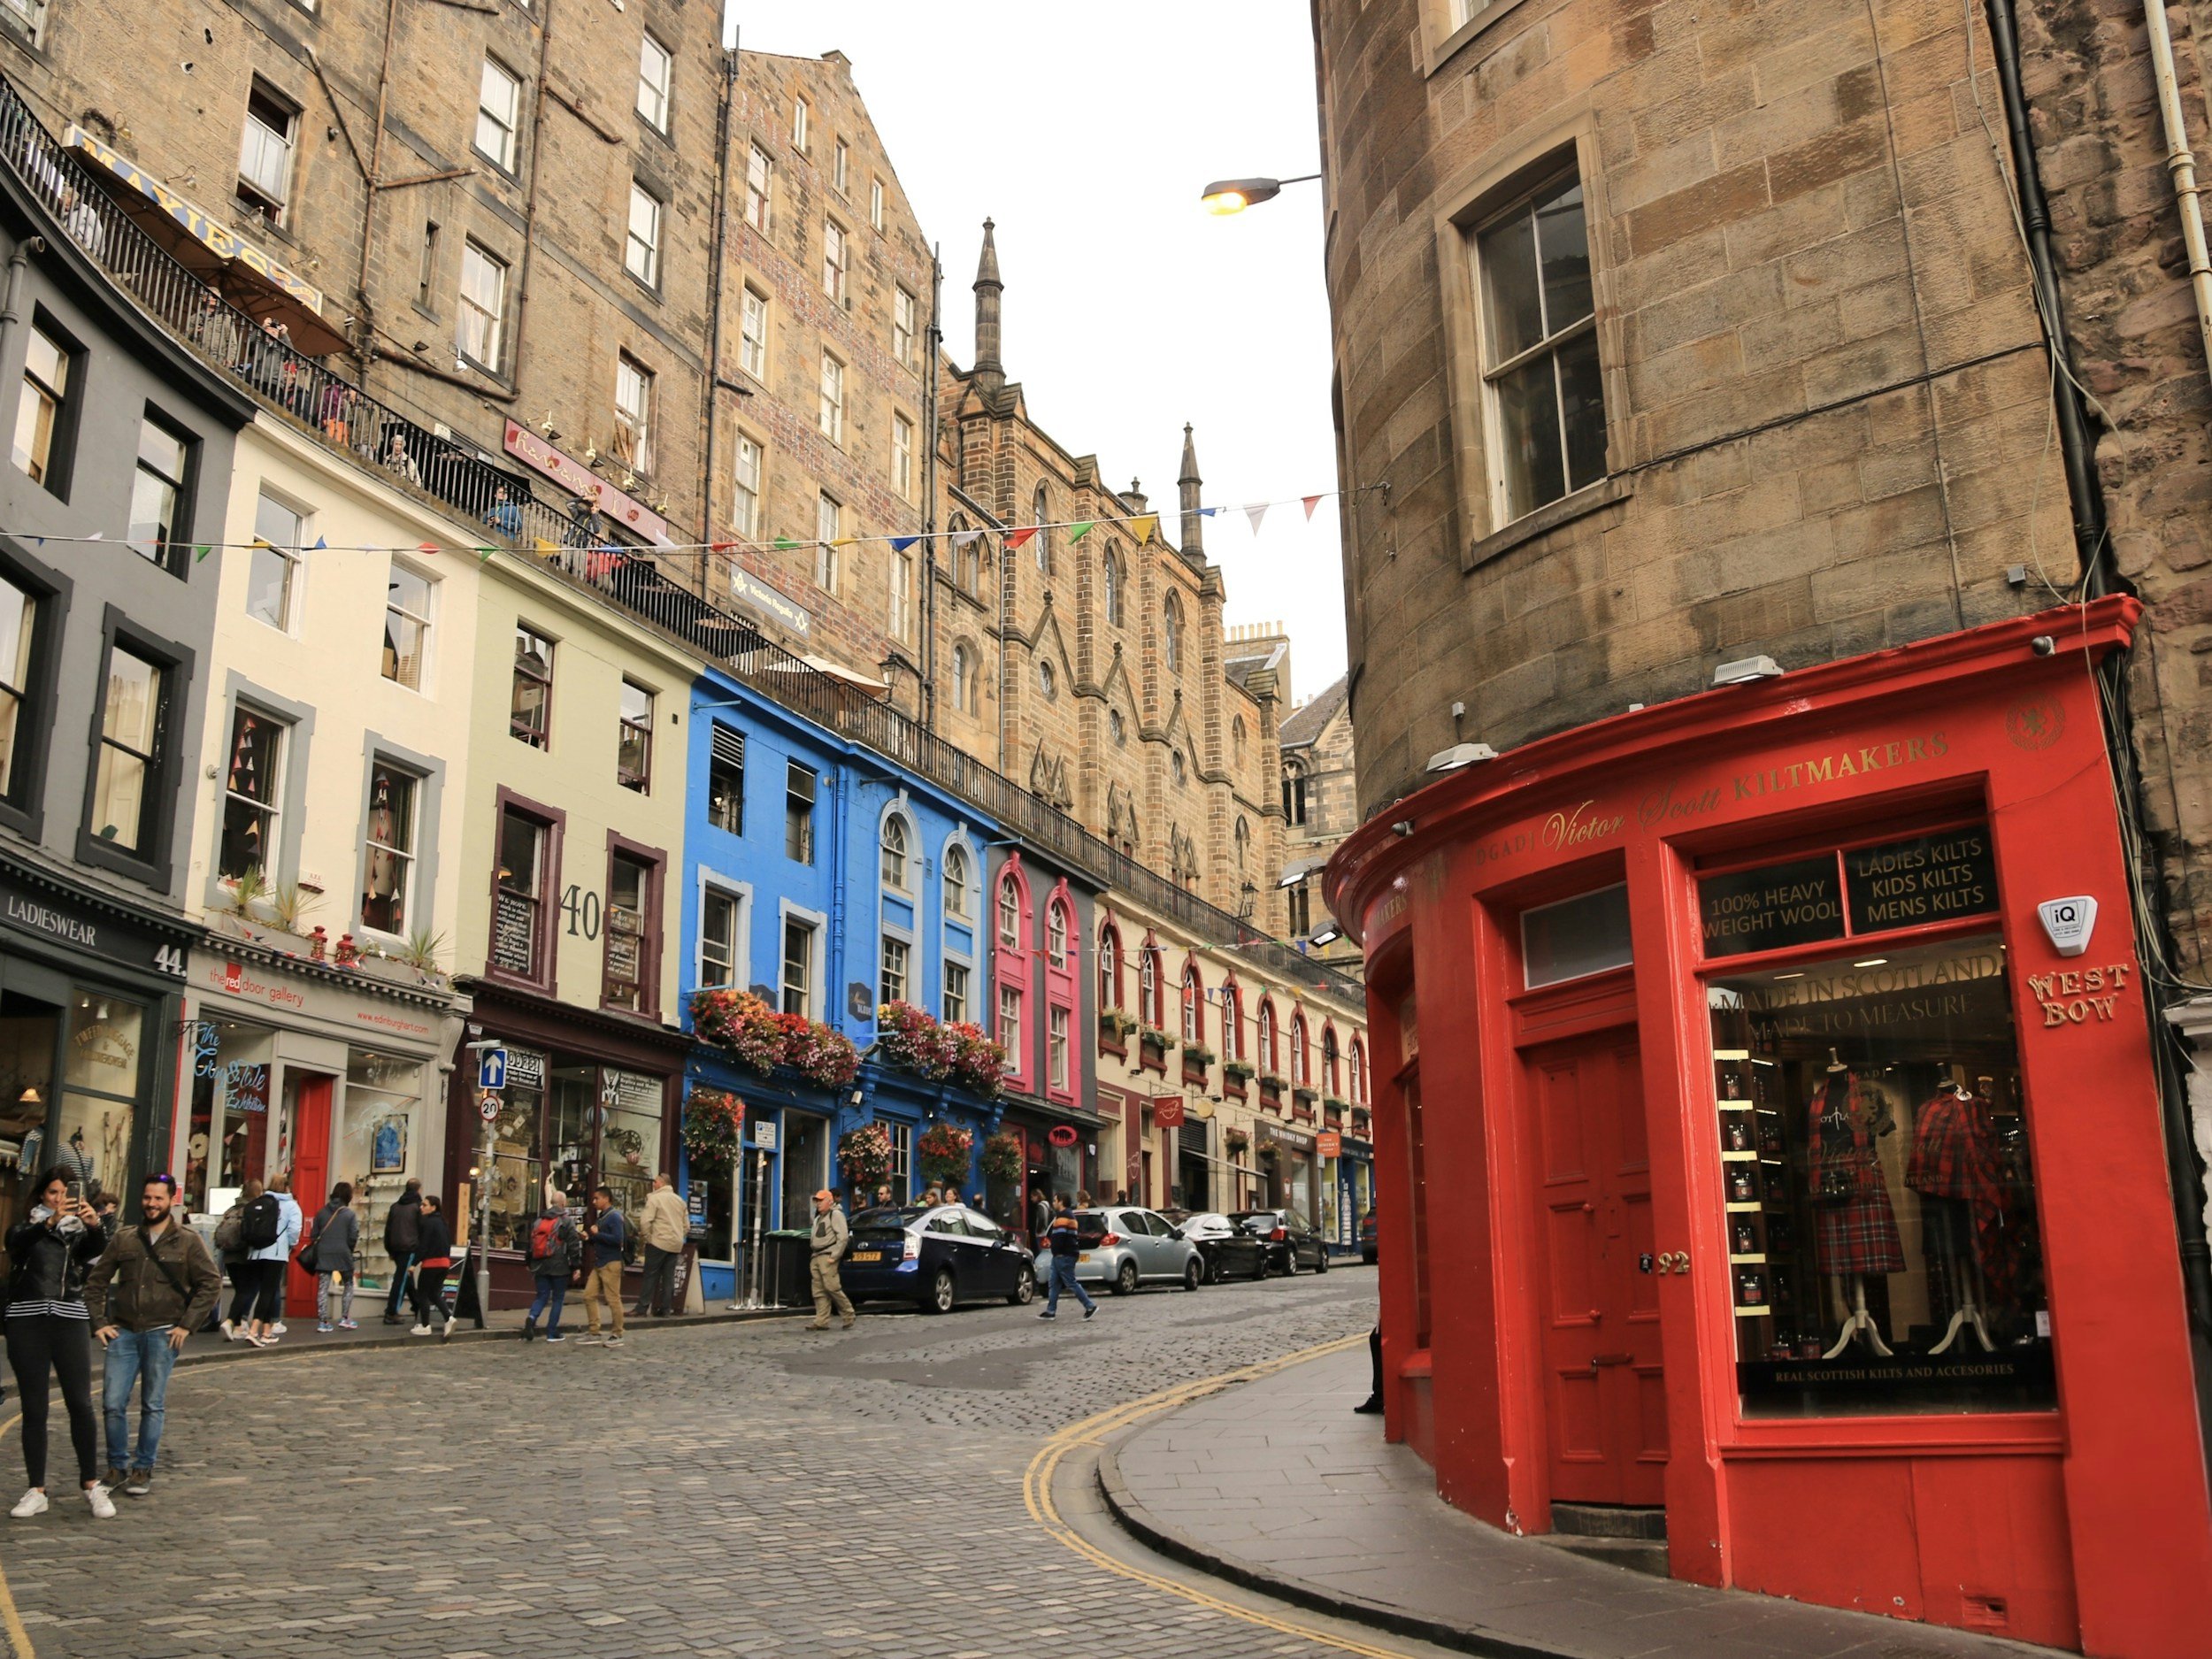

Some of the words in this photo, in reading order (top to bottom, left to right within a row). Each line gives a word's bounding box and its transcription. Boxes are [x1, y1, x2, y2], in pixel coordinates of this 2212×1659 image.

[749, 584, 772, 606] Victoria
[772, 598, 794, 619] Regalia
[1542, 800, 1624, 852] Victor
[1637, 779, 1722, 834] Scott
[1733, 731, 1949, 802] KILTMAKERS
[1858, 855, 1925, 878] LADIES
[1931, 838, 1983, 864] KILTS
[1711, 892, 1761, 917] 100%
[1765, 880, 1825, 906] HEAVY
[1872, 874, 1916, 899] KIDS
[1922, 864, 1974, 890] KILTS
[7, 895, 96, 947] LADIESWEAR
[560, 884, 600, 941] 40
[1702, 911, 1775, 940] WEIGHT
[1780, 901, 1841, 926] WOOL
[1867, 897, 1927, 924] MENS
[1932, 886, 1985, 912] KILTS
[2055, 906, 2076, 923] iQ
[210, 968, 225, 985] the
[226, 974, 241, 989] red
[242, 978, 265, 995] door
[269, 985, 303, 1008] gallery
[1720, 982, 1800, 1016] MADE
[1804, 977, 1835, 1002] IN
[1840, 954, 1998, 1001] SCOTLAND
[2028, 964, 2130, 1002] WEST
[357, 1011, 429, 1033] www.edinburghart.com
[857, 1003, 872, 1016] BLEUE
[1749, 1018, 1810, 1041] MADE
[1821, 1010, 1852, 1033] TO
[1859, 993, 1974, 1025] MEASURE
[2042, 993, 2119, 1026] BOW
[197, 1021, 220, 1047] The
[483, 1103, 496, 1114] 20
[1270, 1127, 1279, 1137] THE
[1279, 1131, 1295, 1142] WHISKY
[1296, 1133, 1308, 1145] SHOP
[1658, 1251, 1690, 1273] 92
[1776, 1371, 1805, 1382] REAL
[1808, 1369, 1865, 1381] SCOTTISH
[1869, 1367, 1903, 1379] KILTS
[1906, 1366, 1932, 1378] AND
[1936, 1363, 2016, 1377] ACCESORIES
